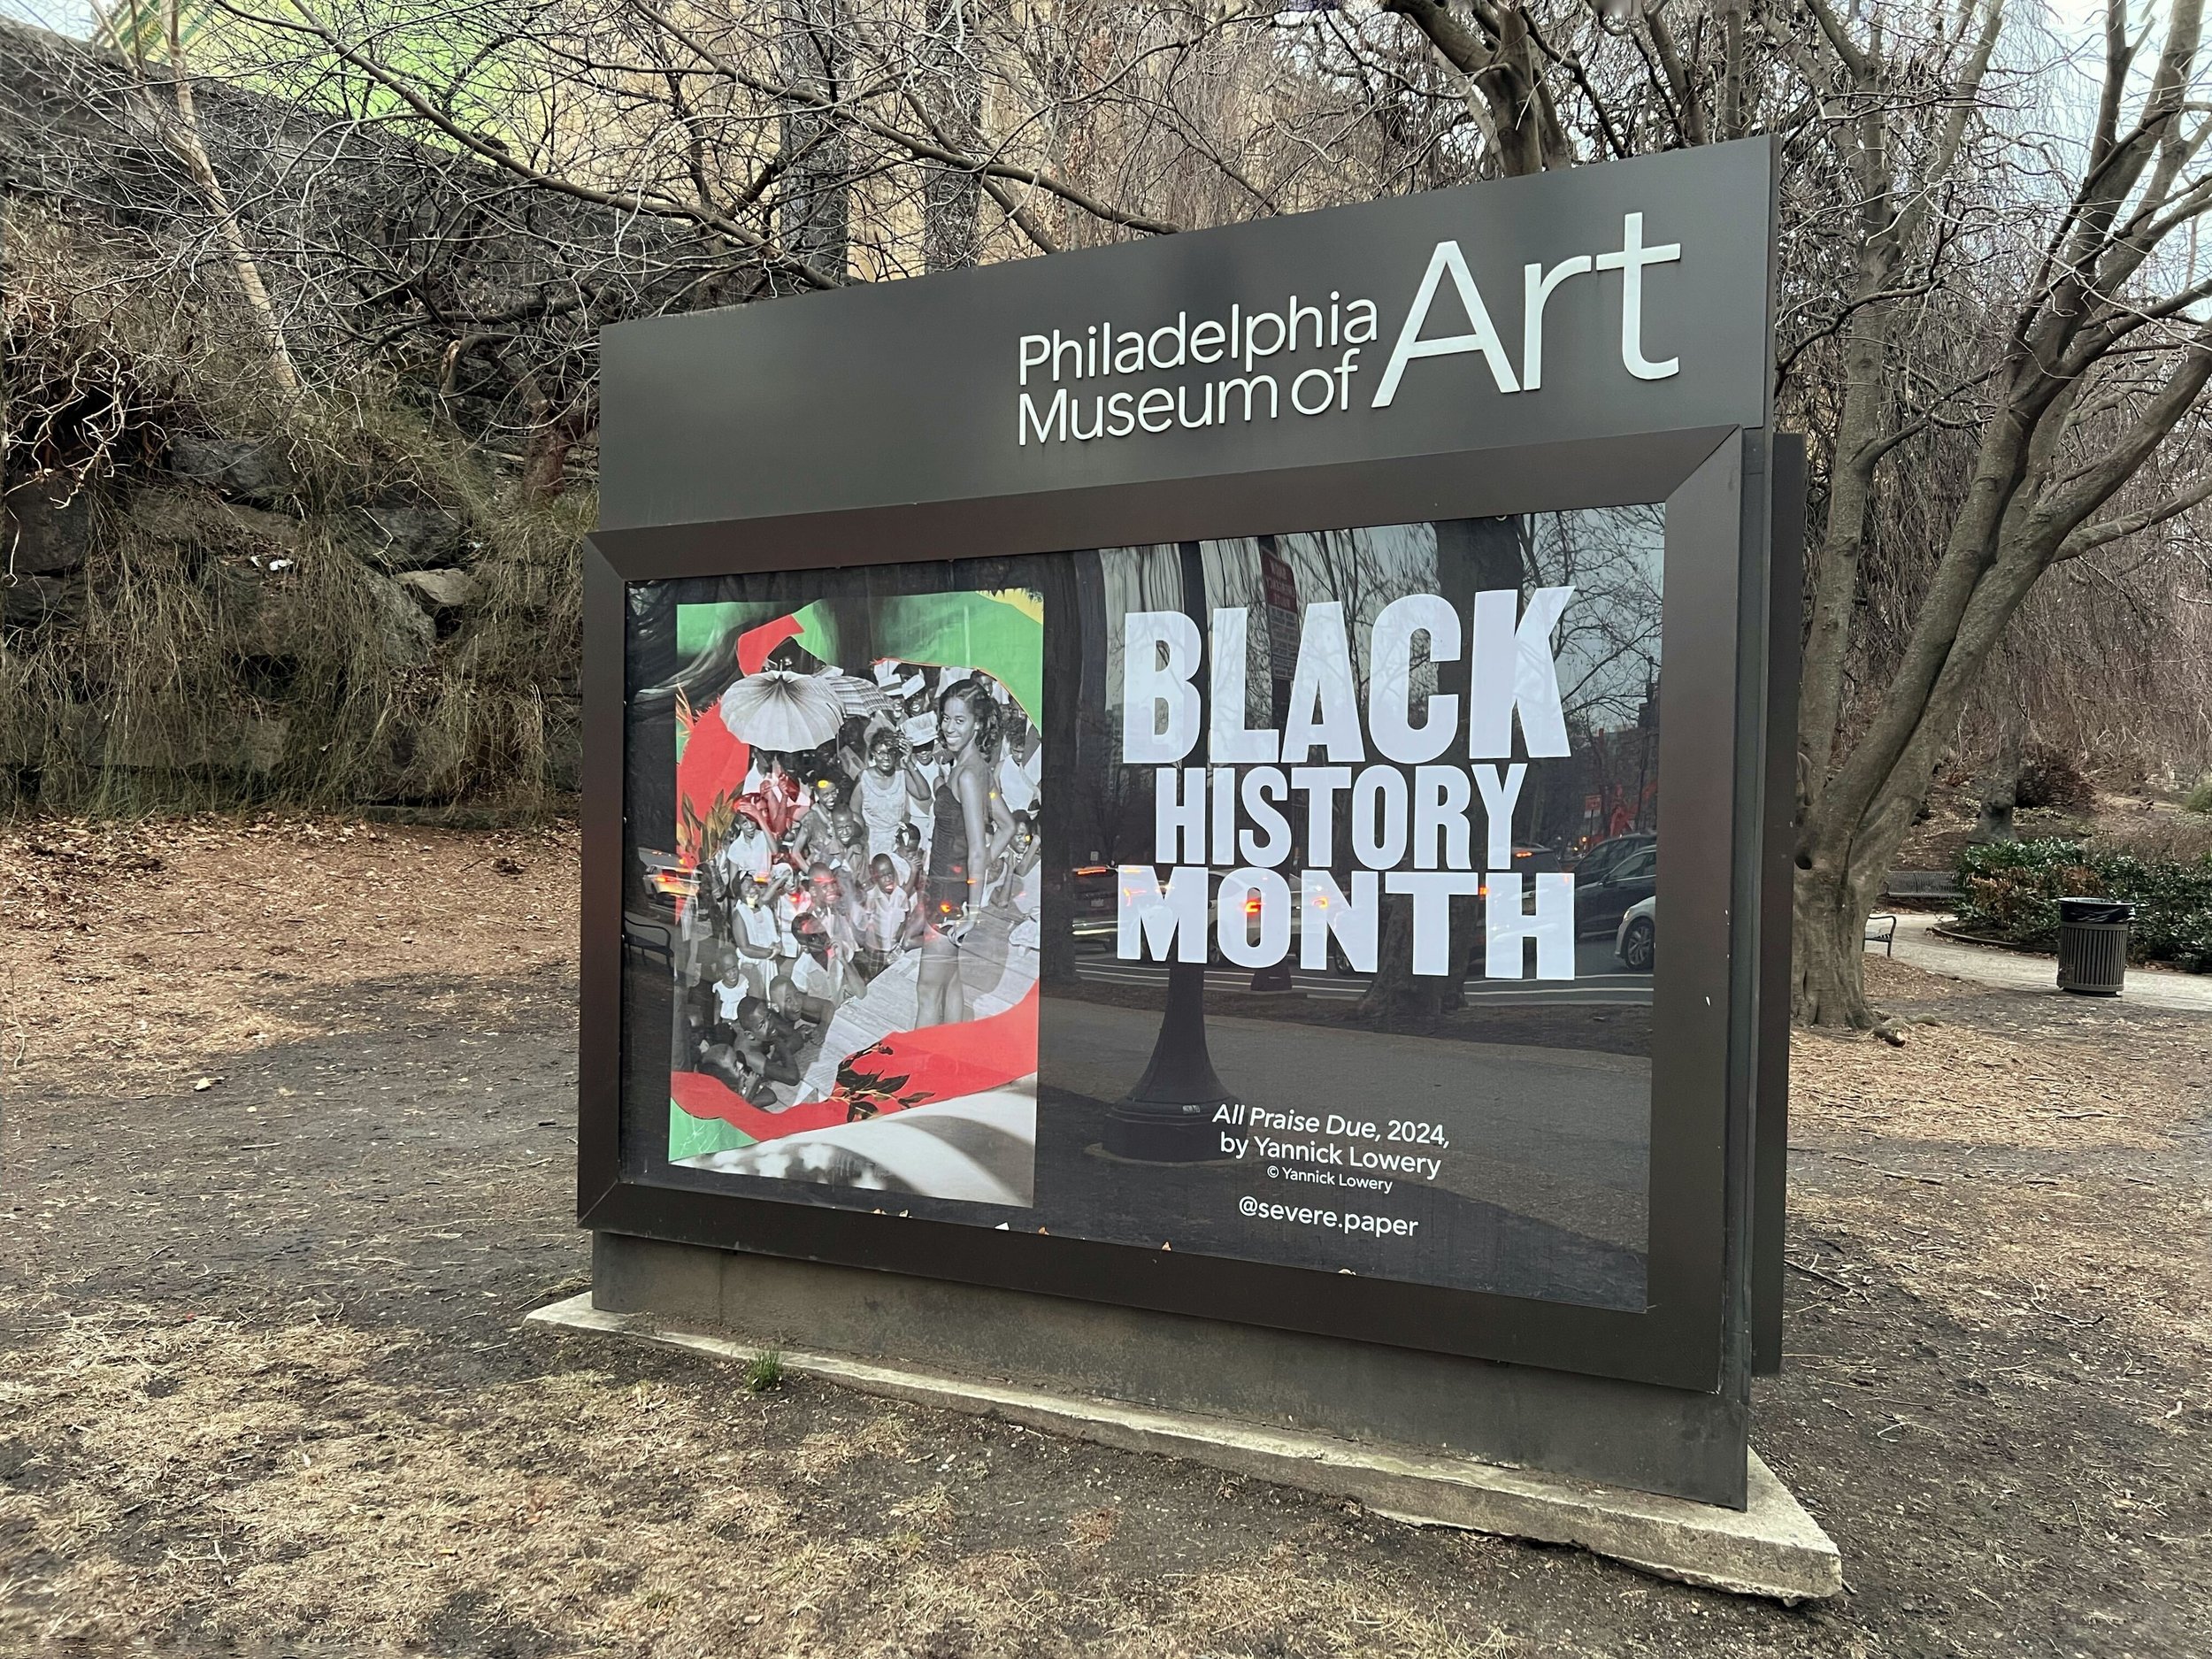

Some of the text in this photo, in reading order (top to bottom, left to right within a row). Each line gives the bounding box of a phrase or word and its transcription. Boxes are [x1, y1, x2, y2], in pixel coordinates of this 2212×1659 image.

[1018, 211, 1682, 446] Museum of Art
[1018, 290, 1379, 386] Philadelphia
[1122, 584, 1577, 764] BLACK
[1155, 763, 1529, 871] HISTORY
[1116, 864, 1576, 981] MONTH
[1211, 1103, 1450, 1149] All Praise Due, 2024,
[1220, 1131, 1442, 1180] by Yannick Lowery
[1239, 1195, 1419, 1238] @severe.paper
[1281, 1166, 1336, 1186] Yannick
[1339, 1173, 1394, 1194] Lowery
